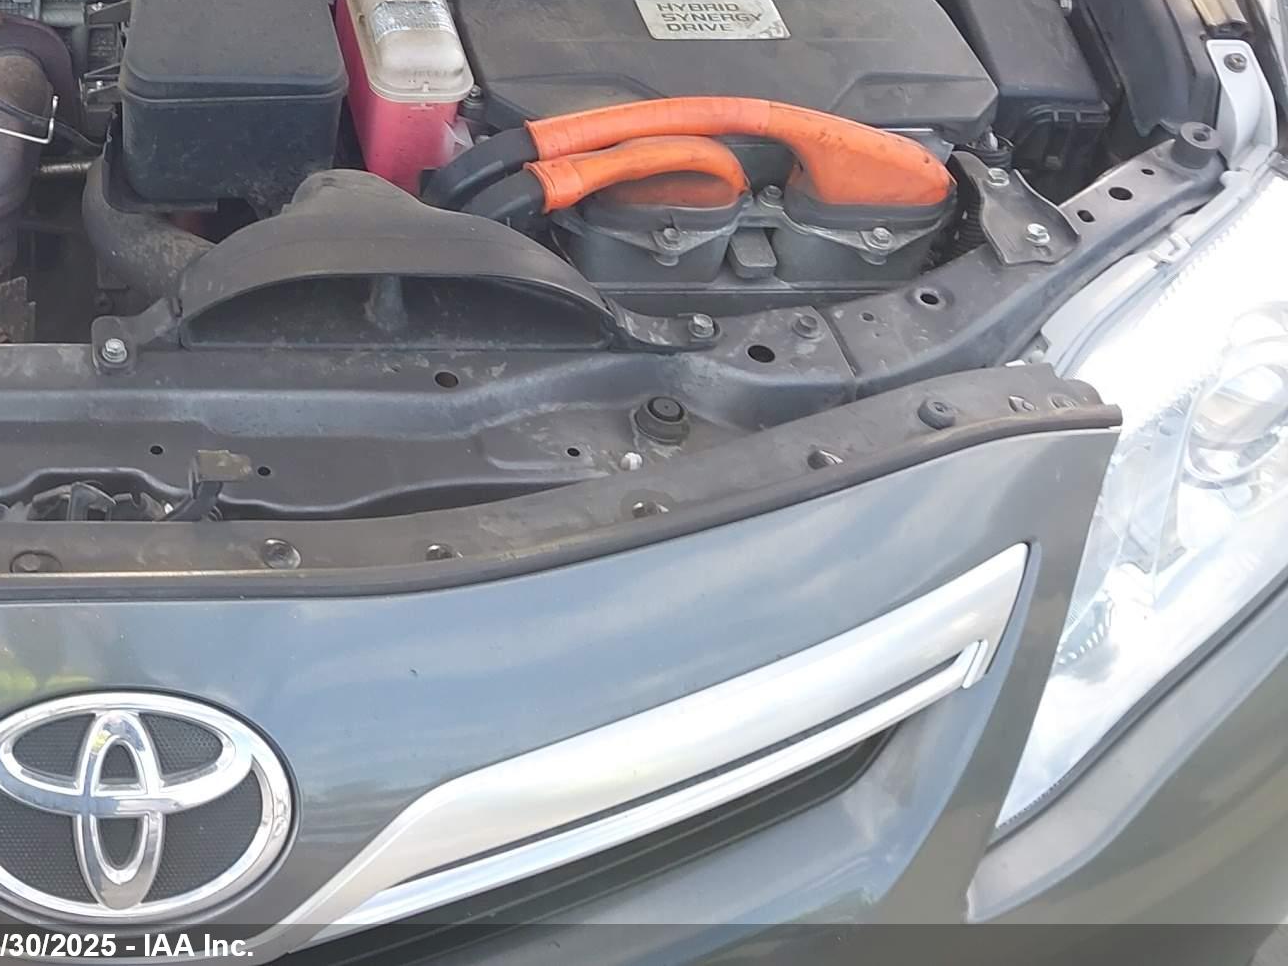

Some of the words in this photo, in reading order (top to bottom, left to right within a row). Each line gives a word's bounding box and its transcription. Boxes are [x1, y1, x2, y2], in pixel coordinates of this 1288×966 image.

[657, 2, 739, 12] HYBRID
[661, 12, 763, 22] SYNERGY
[666, 22, 734, 32] DRIVE
